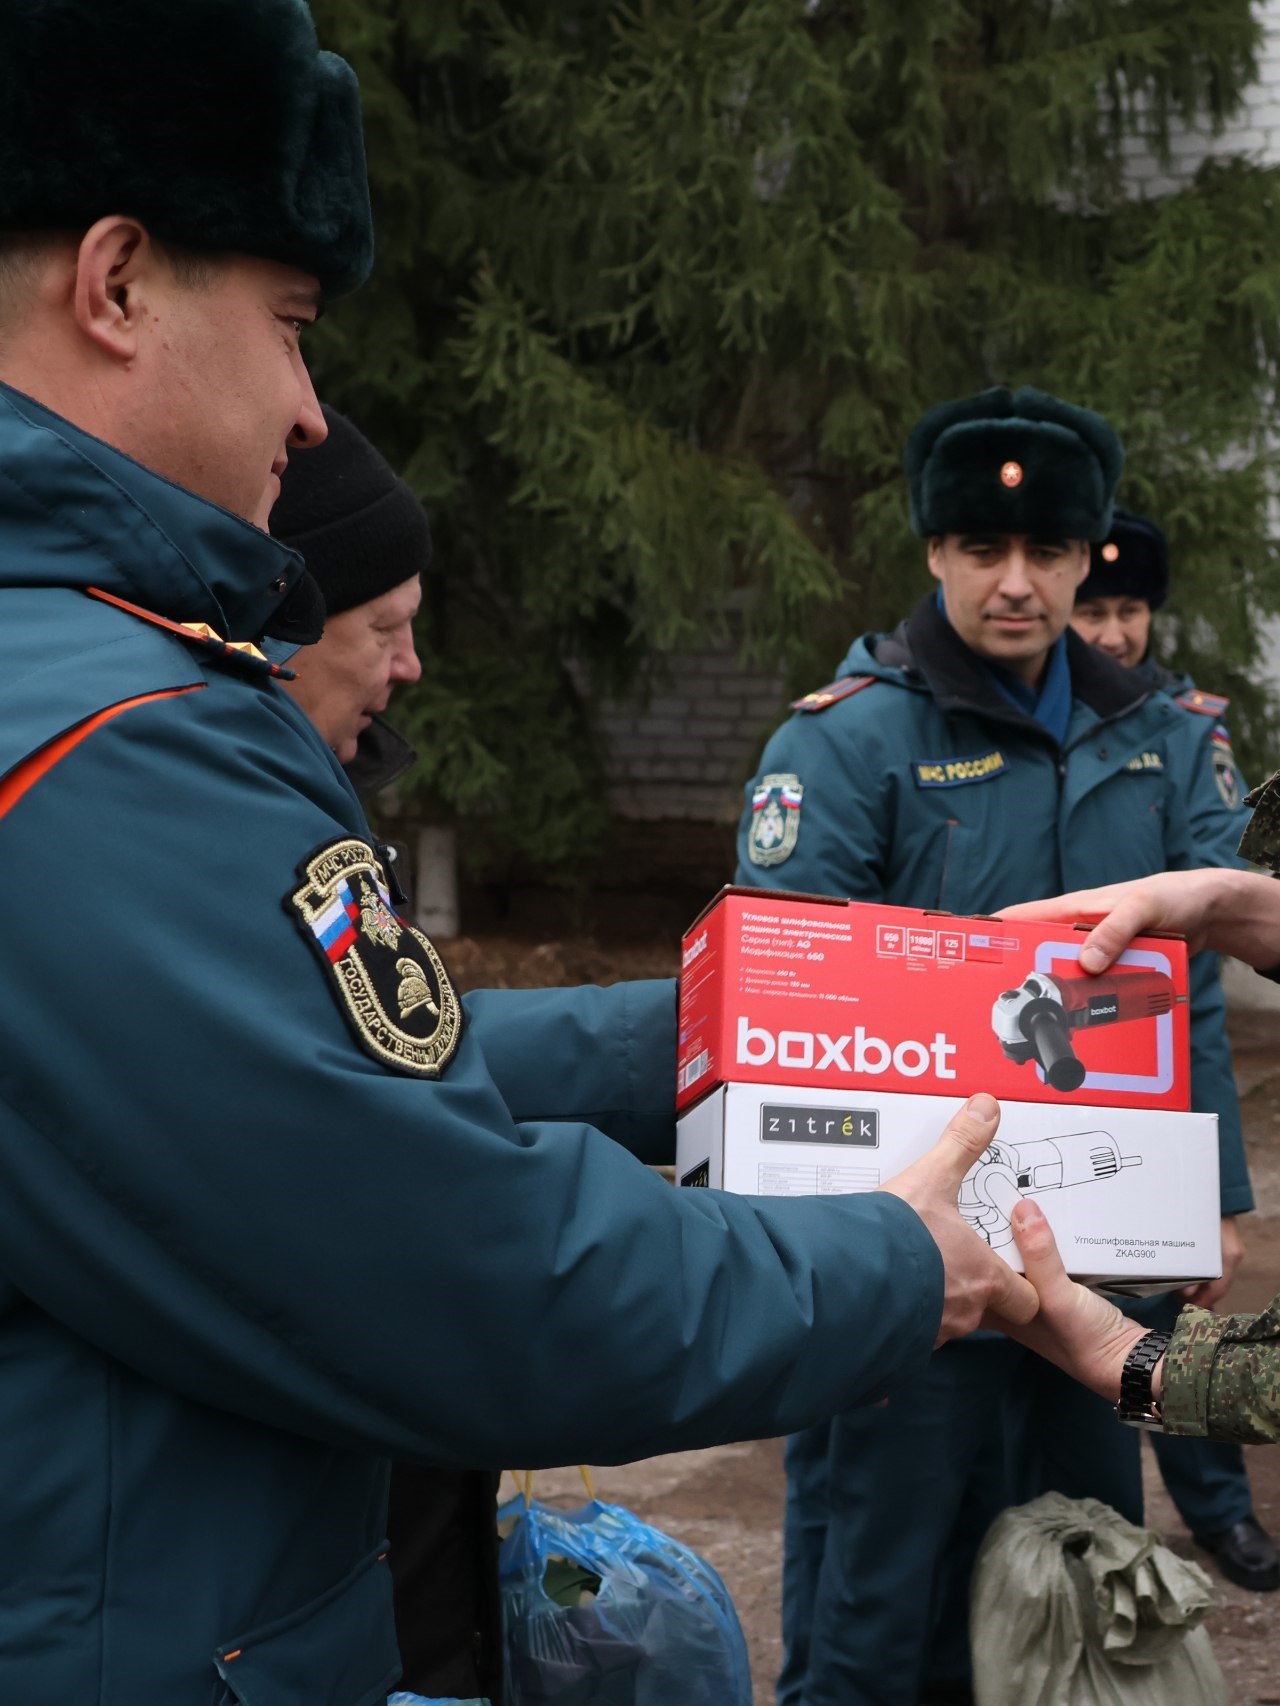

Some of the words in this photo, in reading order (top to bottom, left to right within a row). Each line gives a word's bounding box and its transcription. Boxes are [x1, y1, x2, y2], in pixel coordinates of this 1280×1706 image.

[317, 856, 342, 884] МЧС
[742, 912, 779, 923] Угловая
[781, 917, 851, 931] шлифовальная
[741, 925, 781, 935] машина
[783, 928, 852, 942] электрическая
[944, 939, 958, 948] 125
[736, 1016, 956, 1079] boxbot
[1074, 1236, 1160, 1247] Углошлифовальная
[1161, 1240, 1196, 1248] машина
[1115, 1249, 1156, 1259] ZKAG900
